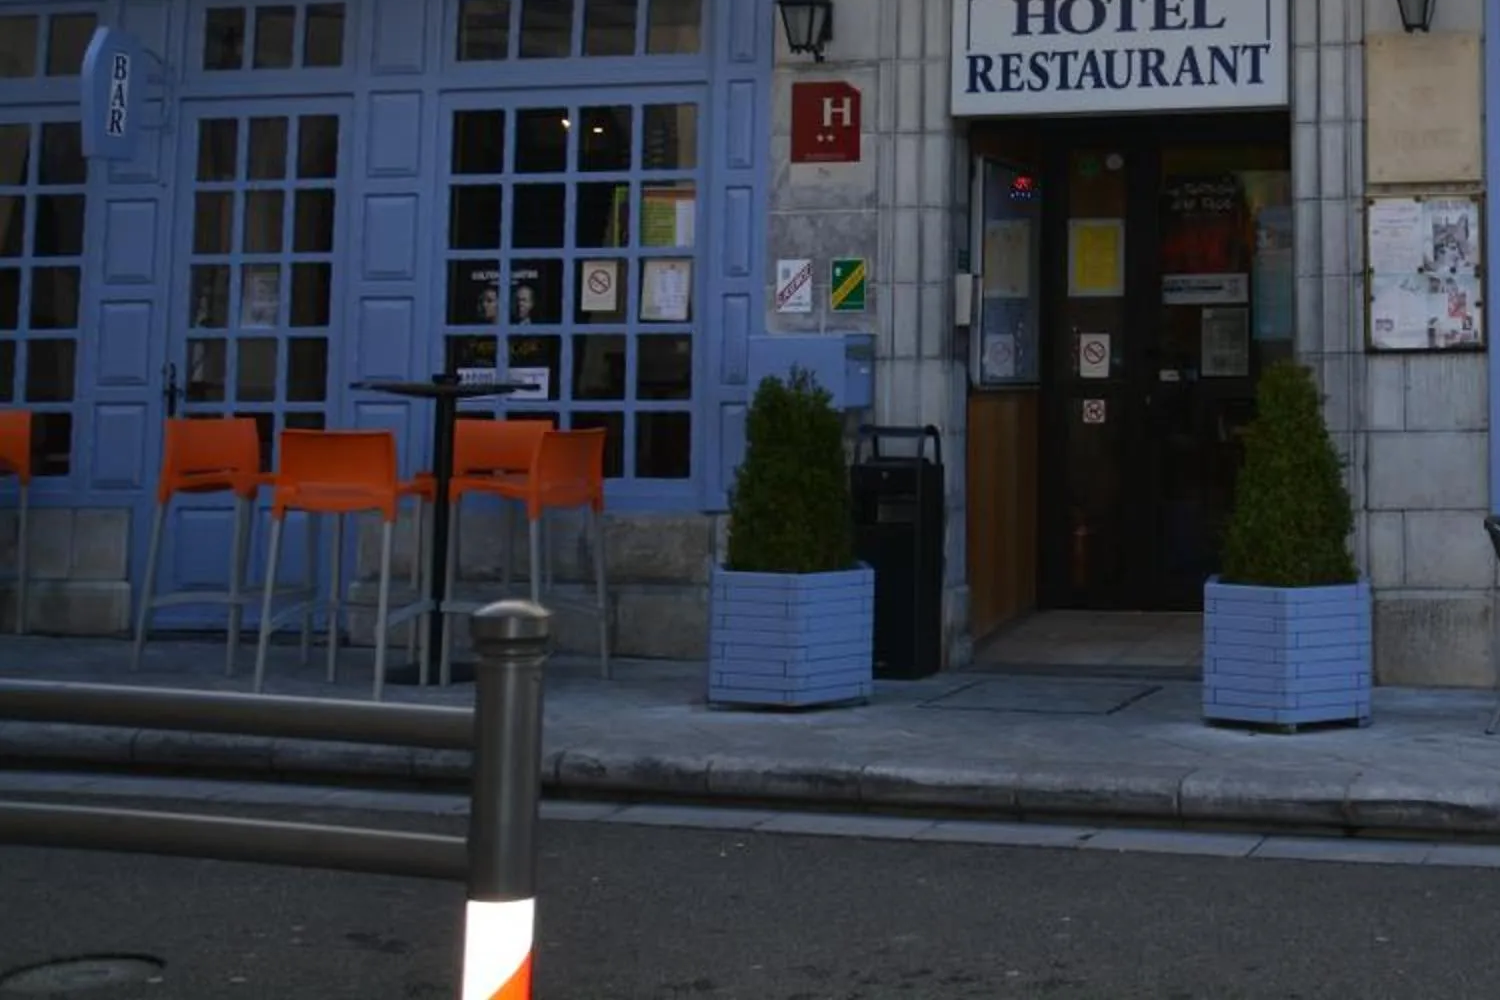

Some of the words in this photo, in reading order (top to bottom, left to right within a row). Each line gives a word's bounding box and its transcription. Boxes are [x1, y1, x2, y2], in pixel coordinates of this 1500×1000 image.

[965, 43, 1270, 93] RESTAURANT
[110, 55, 128, 134] BAR
[822, 97, 852, 127] H
